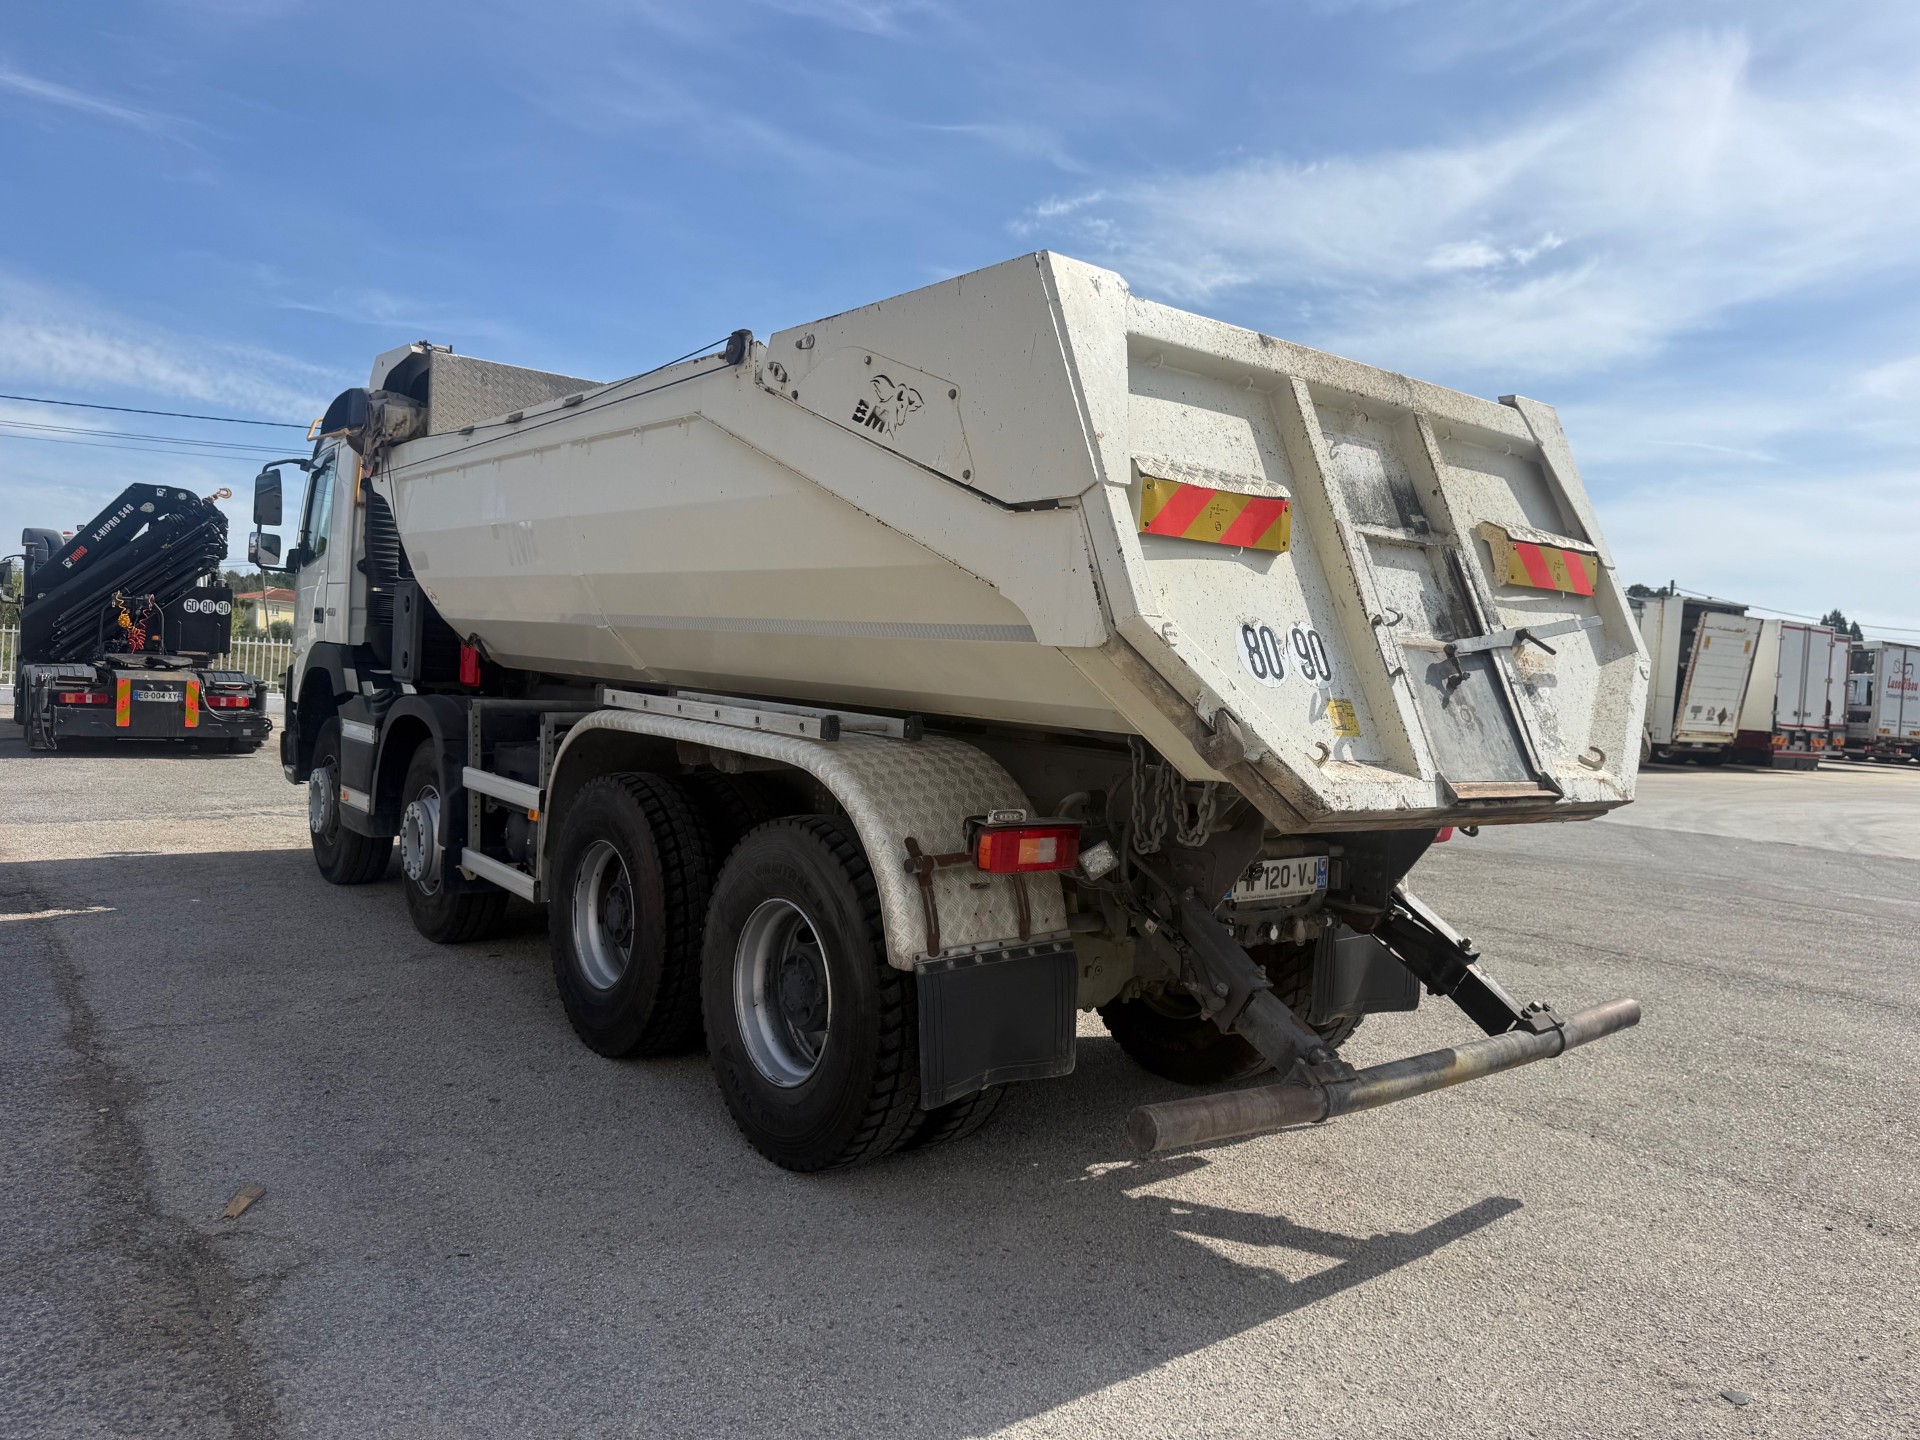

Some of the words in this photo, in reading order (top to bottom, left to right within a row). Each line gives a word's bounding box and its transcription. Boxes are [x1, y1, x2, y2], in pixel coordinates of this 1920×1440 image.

[92, 516, 121, 542] X-HIPRO
[118, 503, 134, 519] 548
[187, 600, 197, 612] 60
[203, 601, 213, 612] 80
[218, 602, 228, 613] 90
[1242, 624, 1284, 680] 80
[1292, 627, 1331, 681] 90
[1234, 862, 1317, 893] 120-VJ
[1318, 875, 1325, 886] 33
